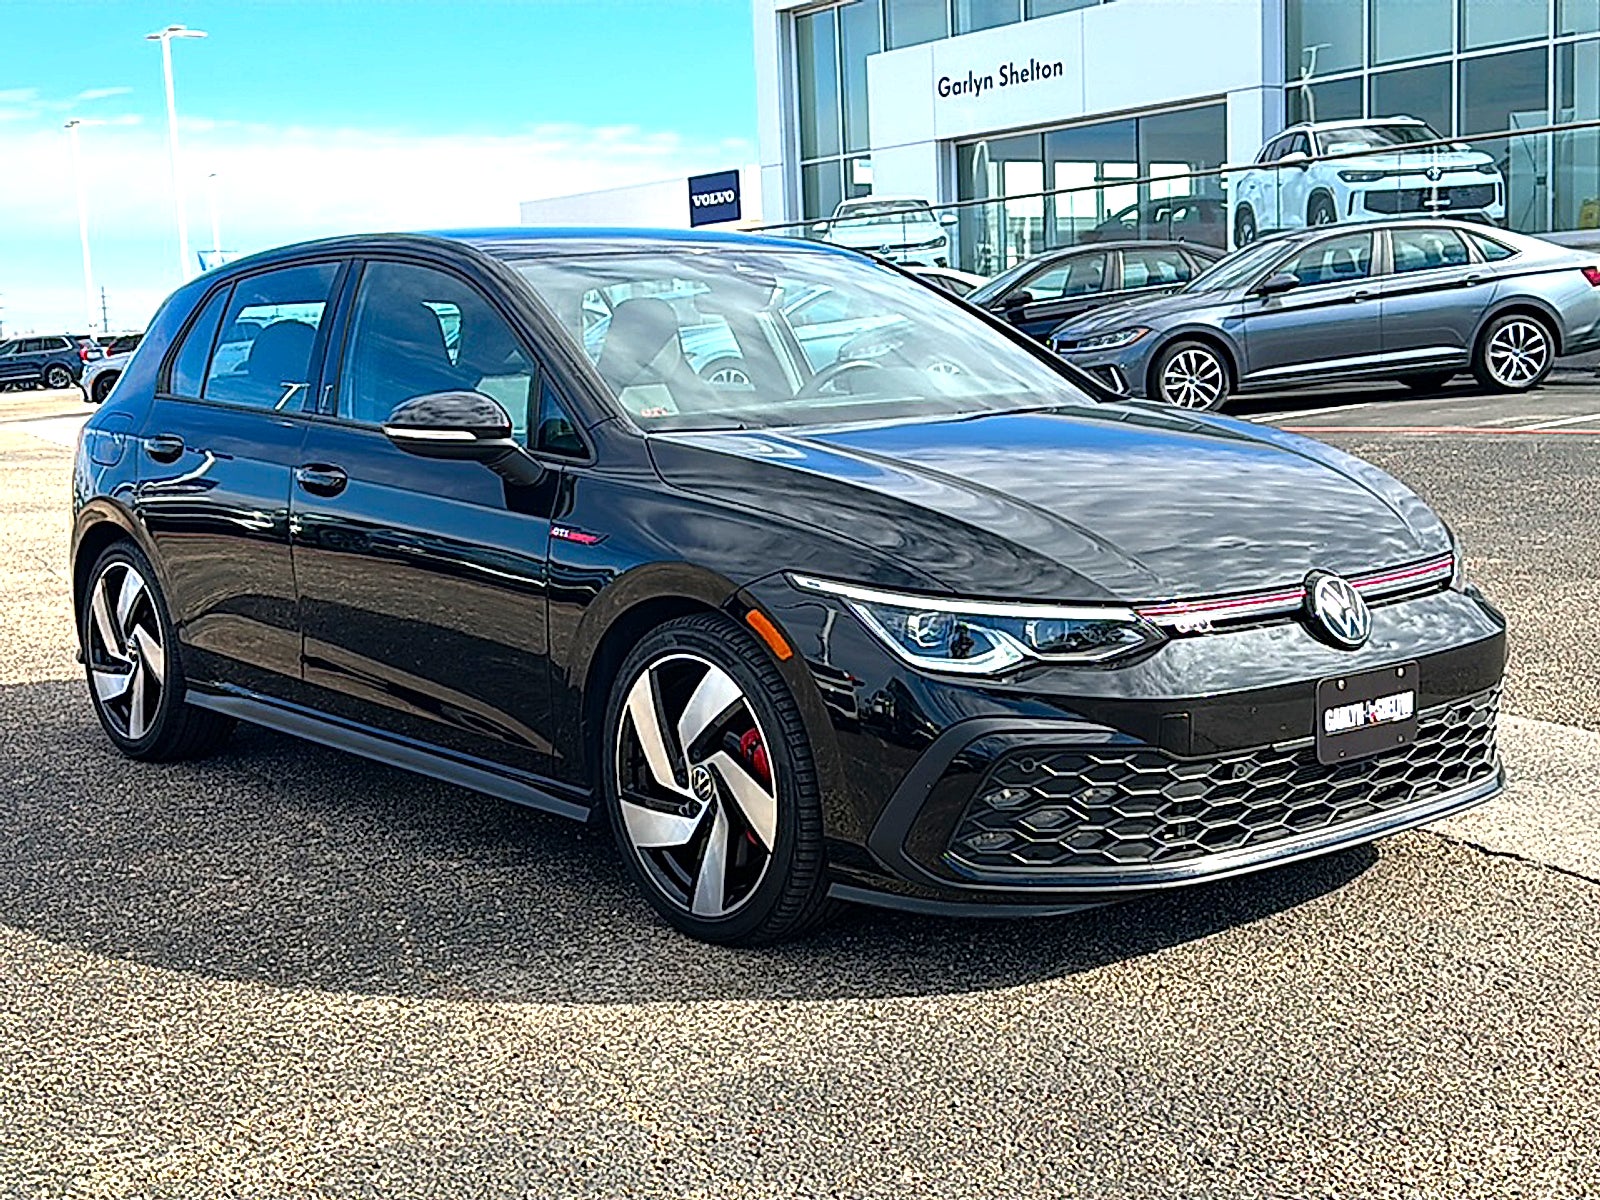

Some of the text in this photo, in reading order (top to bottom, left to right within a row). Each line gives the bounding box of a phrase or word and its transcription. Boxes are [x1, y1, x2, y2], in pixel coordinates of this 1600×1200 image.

[938, 58, 1063, 97] Garlyn Shelton
[692, 190, 735, 206] VOLVO
